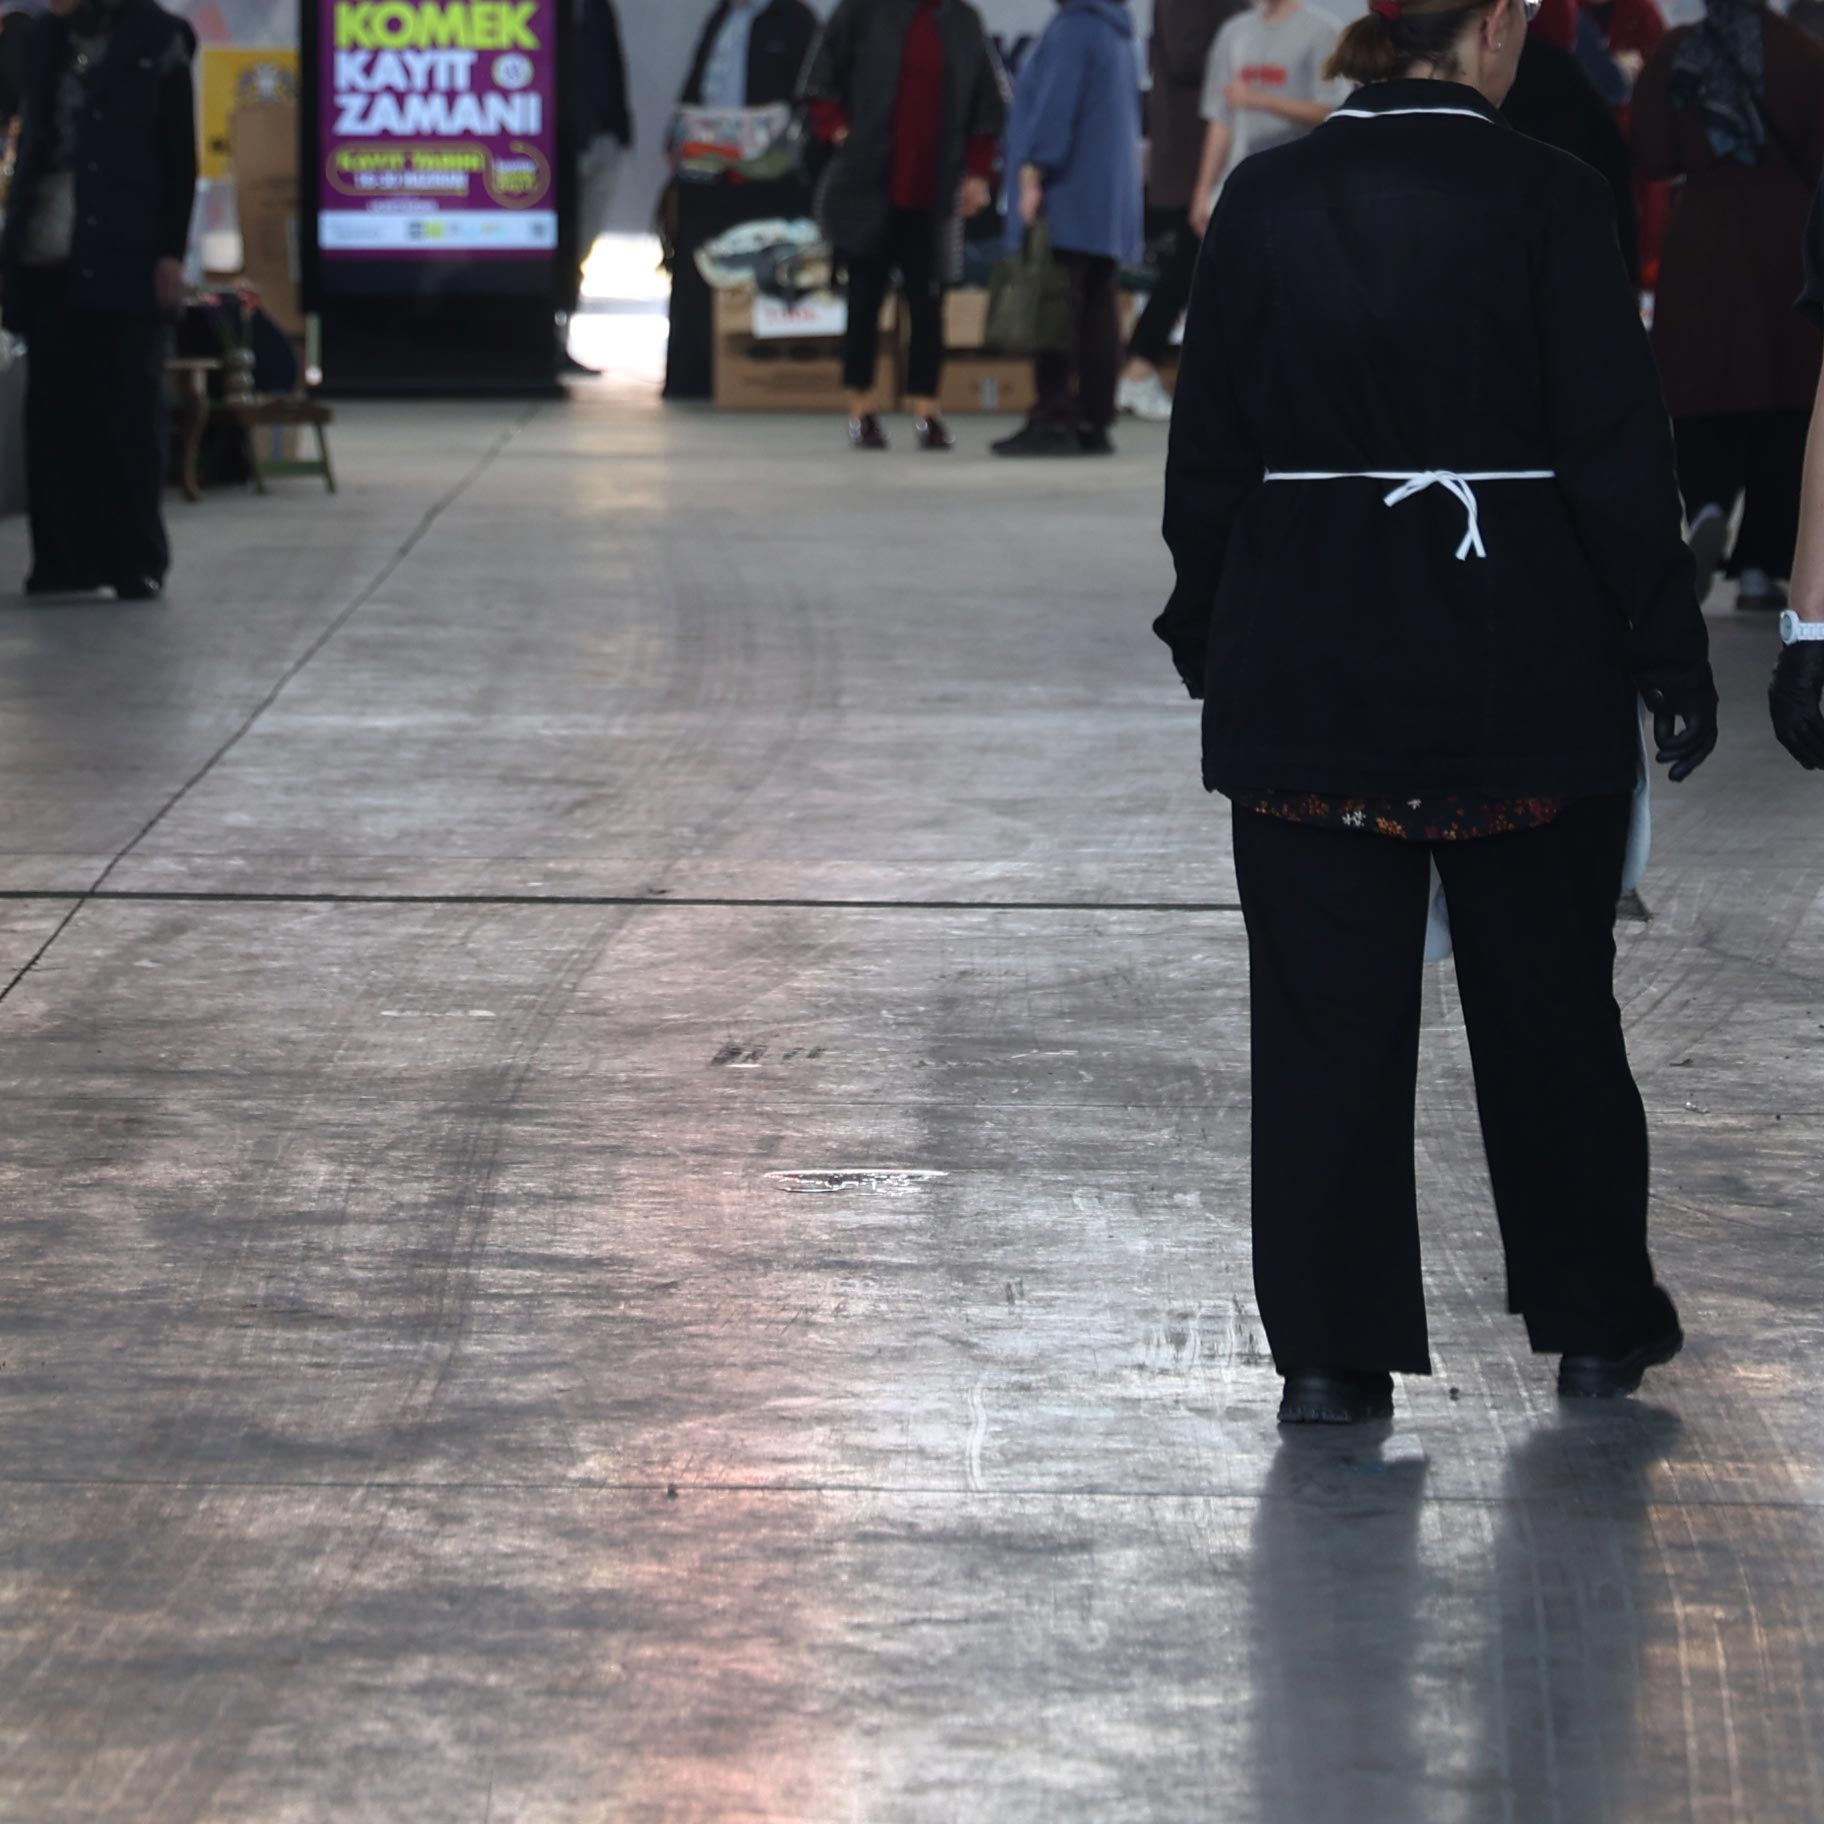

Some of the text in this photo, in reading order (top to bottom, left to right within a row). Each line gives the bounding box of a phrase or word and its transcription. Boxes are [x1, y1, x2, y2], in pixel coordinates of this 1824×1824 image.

[334, 0, 541, 50] KOMEK
[333, 49, 478, 92] KAYIT
[333, 92, 543, 136] ZAMANI
